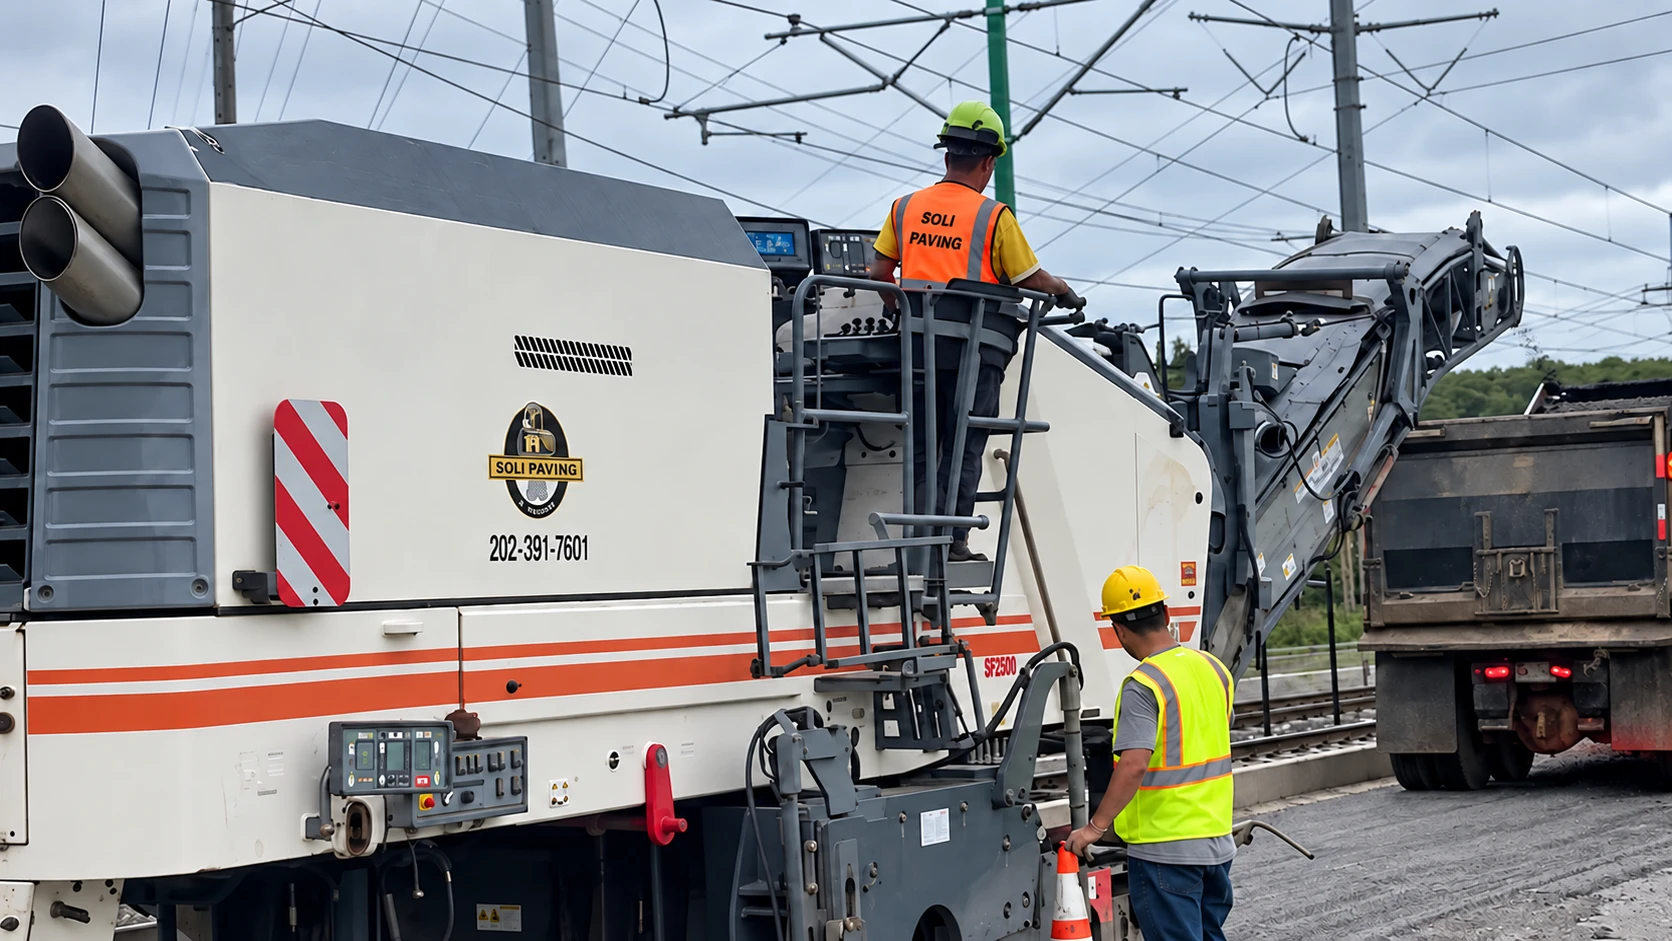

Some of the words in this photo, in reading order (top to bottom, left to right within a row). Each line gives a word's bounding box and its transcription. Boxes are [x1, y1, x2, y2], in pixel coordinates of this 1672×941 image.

[921, 212, 956, 227] SOLI
[909, 231, 962, 250] PAVING
[496, 462, 525, 475] SOLI
[529, 463, 577, 476] PAVING
[489, 534, 588, 561] 202-391-7601
[984, 655, 1017, 678] SF2500
